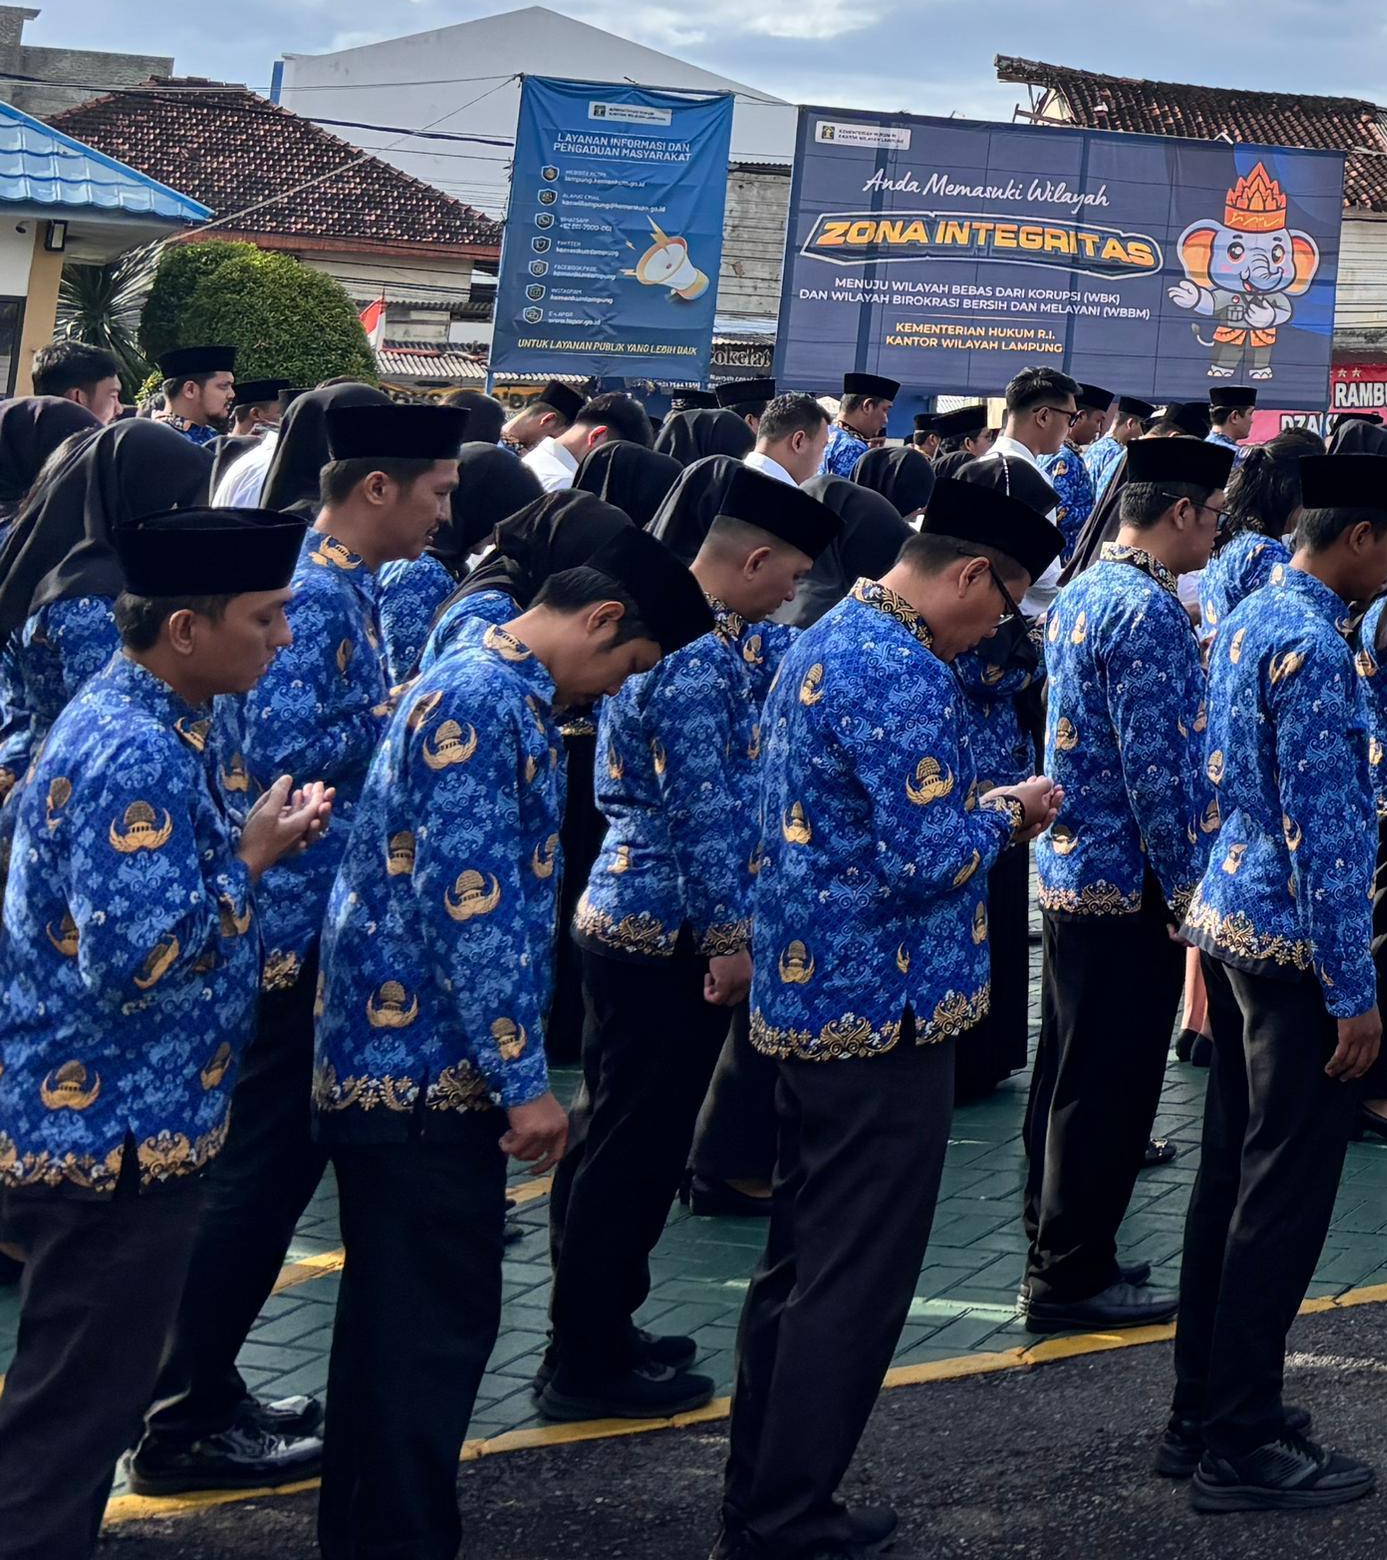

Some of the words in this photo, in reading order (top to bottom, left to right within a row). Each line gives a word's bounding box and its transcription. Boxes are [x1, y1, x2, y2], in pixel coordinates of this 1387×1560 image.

[553, 142, 620, 156] PENGADUAN
[621, 148, 692, 161] MASYARAKAT
[557, 132, 609, 146] LAYANAN
[610, 138, 666, 151] INFORMASI
[668, 142, 690, 153] DAN
[862, 168, 921, 193] Anda
[921, 173, 1023, 201] Memasuki
[1027, 178, 1110, 214] Wilayah
[816, 220, 929, 246] ZONA
[935, 220, 1155, 267] INTEGRITAS
[834, 277, 889, 290] MENUJU
[892, 280, 949, 294] WILAYAH
[950, 284, 993, 297] BEBAS
[996, 286, 1025, 298] DARI
[1028, 289, 1081, 302] KORUPSI
[1083, 292, 1120, 306] (WBK)
[799, 289, 828, 300] DAN
[831, 291, 889, 304] WILAYAH
[892, 295, 960, 308] BIROKRASI
[962, 299, 1008, 310] BERSIH
[1010, 301, 1037, 312] DAN
[1040, 303, 1100, 316] MELAYANI
[1103, 306, 1151, 320] (WBBM)
[896, 322, 985, 336] KEMENTERIAN
[988, 327, 1035, 338] HUKUM
[1037, 329, 1056, 339] R.I.
[518, 339, 549, 349] UNTUK
[550, 340, 593, 351] LAYANAN
[593, 342, 625, 352] PUBLIK
[627, 344, 650, 354] YANG
[650, 345, 676, 355] LEBIH
[677, 346, 697, 356] BAIK
[886, 335, 938, 348] KANTOR
[941, 338, 998, 350] WILAYAH
[1001, 341, 1063, 353] LAMPUNG
